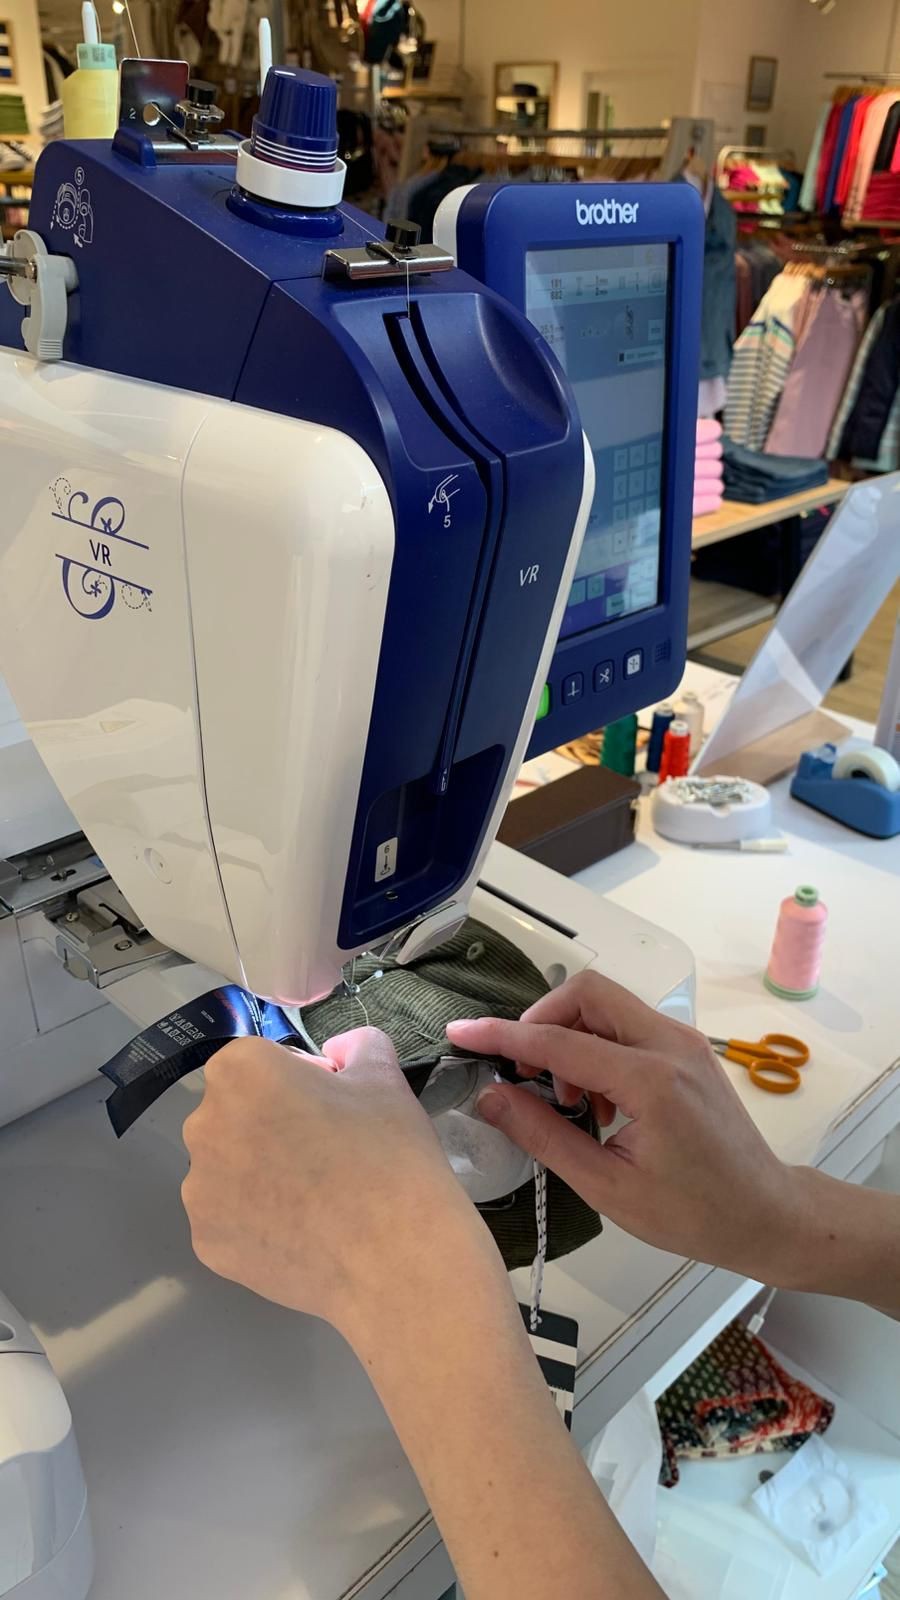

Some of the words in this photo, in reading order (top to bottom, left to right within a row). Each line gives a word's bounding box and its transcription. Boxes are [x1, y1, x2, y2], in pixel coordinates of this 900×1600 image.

[129, 108, 136, 119] 2
[575, 199, 639, 225] brother
[443, 514, 451, 528] 5
[89, 539, 112, 567] VR
[519, 564, 540, 587] VR
[384, 845, 390, 854] 6
